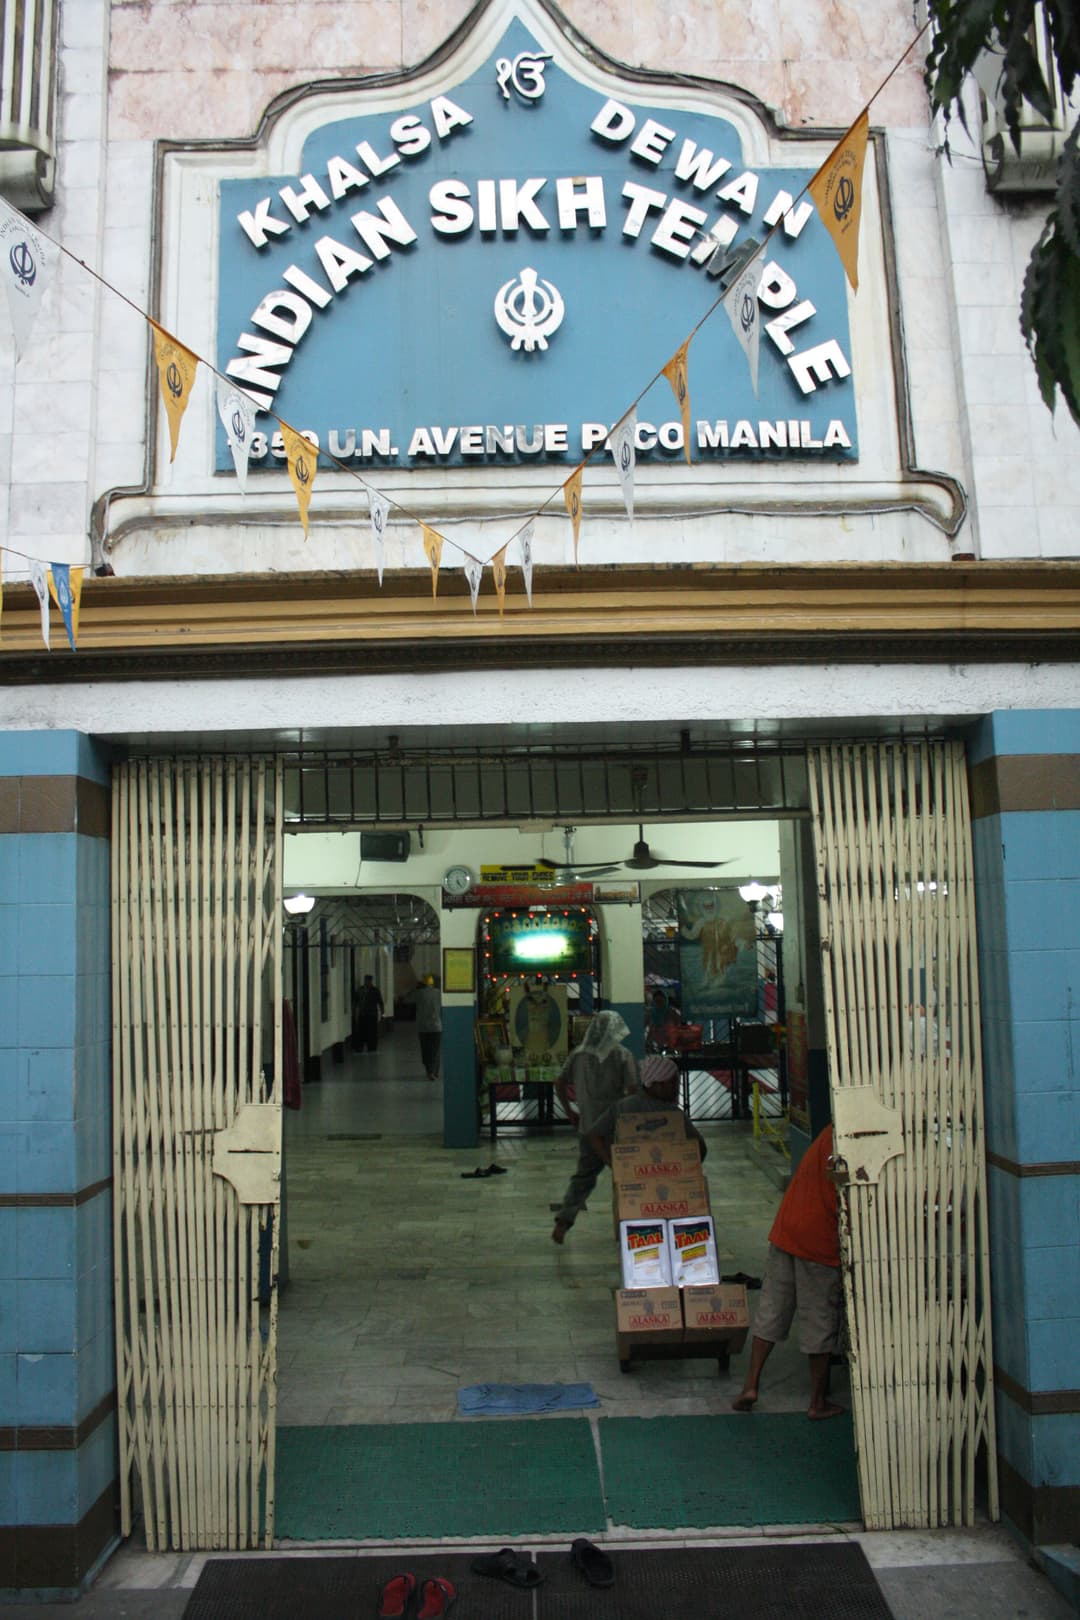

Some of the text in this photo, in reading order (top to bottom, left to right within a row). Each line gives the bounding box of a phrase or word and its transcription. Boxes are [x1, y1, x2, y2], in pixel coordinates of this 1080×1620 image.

[237, 95, 814, 249] KHALSA DEWAN
[429, 177, 606, 234] SIKH
[621, 181, 851, 395] TEMPLE
[227, 430, 320, 459] 35
[328, 428, 398, 458] U.N.
[408, 423, 568, 456] AVENUE
[696, 420, 851, 449] MANILA
[637, 1164, 680, 1176] ALASKA
[644, 1203, 686, 1214] ALASKA
[627, 1232, 664, 1249] TAAL
[675, 1229, 710, 1249] TAAL
[631, 1315, 668, 1325] ALASKA
[699, 1312, 736, 1322] ALASKA
